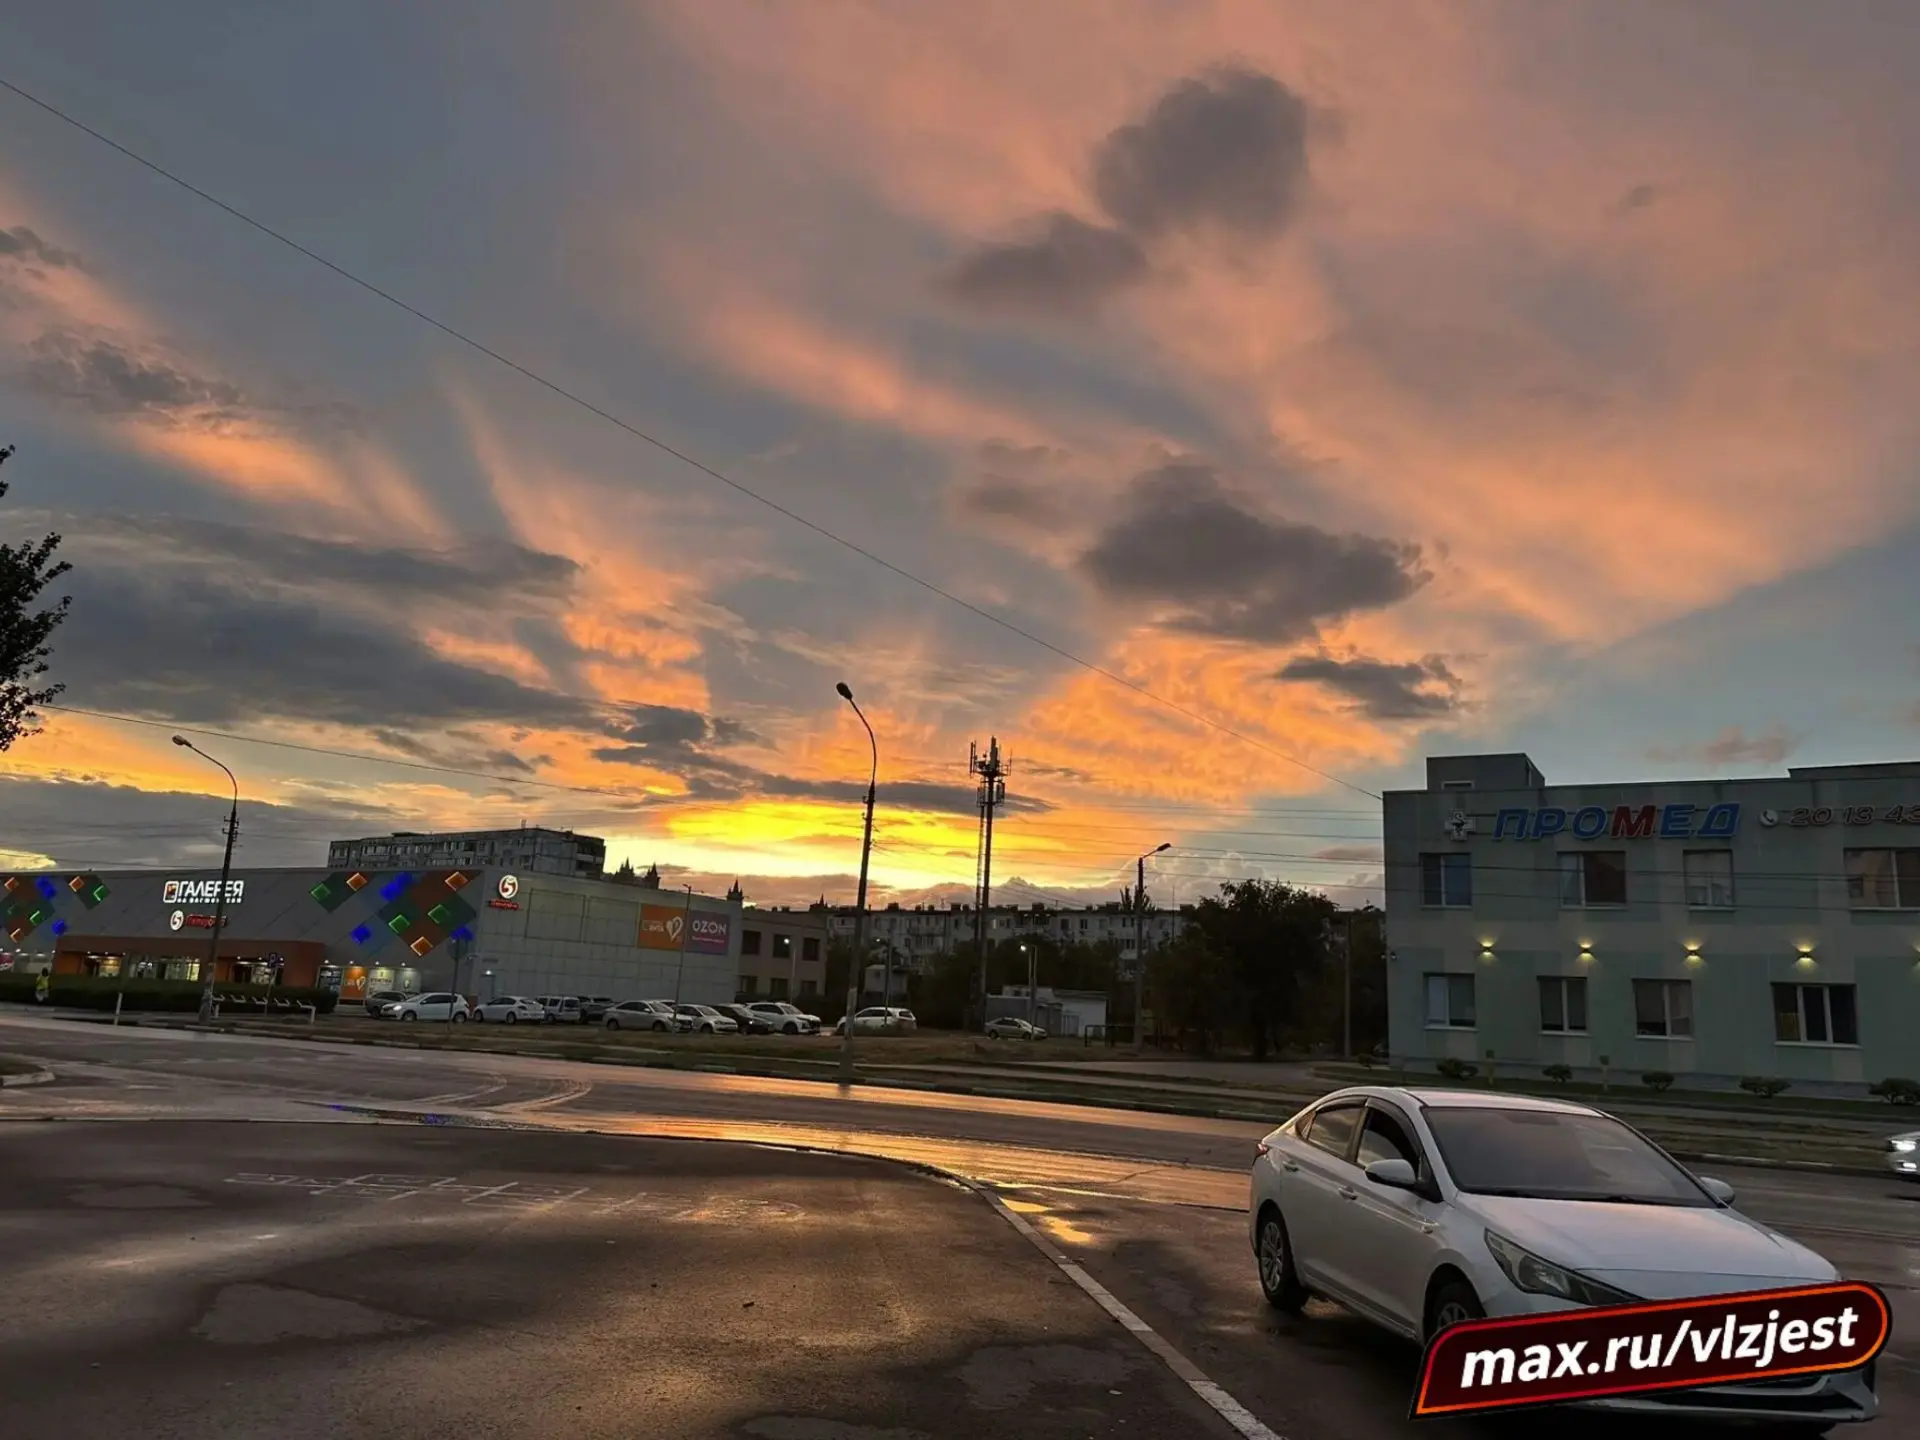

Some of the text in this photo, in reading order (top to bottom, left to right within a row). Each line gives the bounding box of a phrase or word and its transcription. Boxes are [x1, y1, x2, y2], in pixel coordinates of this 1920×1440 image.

[1492, 803, 1741, 840] ПРОМЕД
[1788, 807, 1834, 826] 20
[692, 919, 728, 936] OZON
